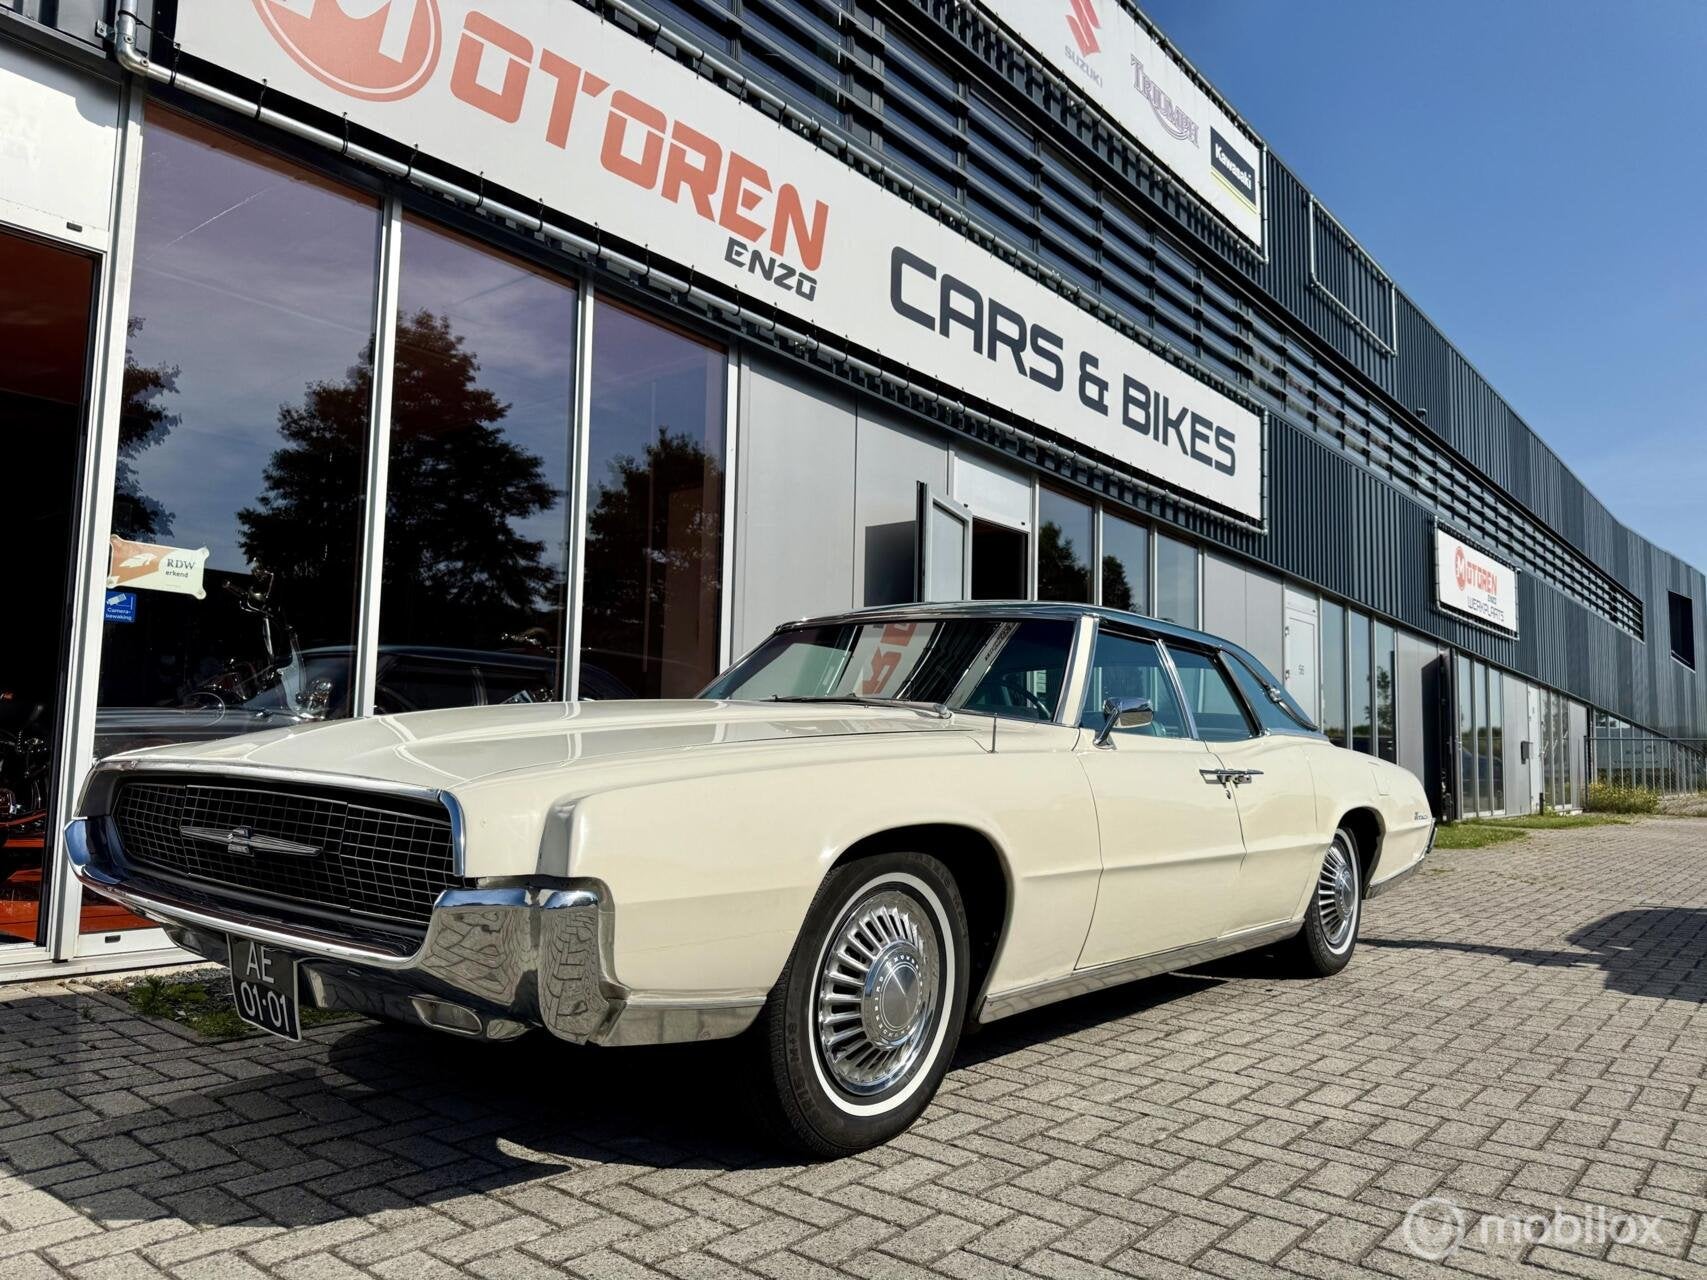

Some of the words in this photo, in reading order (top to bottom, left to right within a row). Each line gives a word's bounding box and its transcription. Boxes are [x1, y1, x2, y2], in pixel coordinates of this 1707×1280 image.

[1064, 45, 1103, 88] SUZUKI
[1130, 54, 1200, 149] TRIUMPH
[1214, 143, 1252, 190] Kawasaki
[725, 237, 818, 303] ENZO
[890, 246, 1064, 392] CARS
[1078, 350, 1109, 417] &
[1122, 373, 1237, 477] BIKES
[165, 570, 189, 578] erkend
[166, 559, 196, 570] RDW
[1455, 548, 1498, 595] MOTOREN
[246, 941, 275, 984] AE
